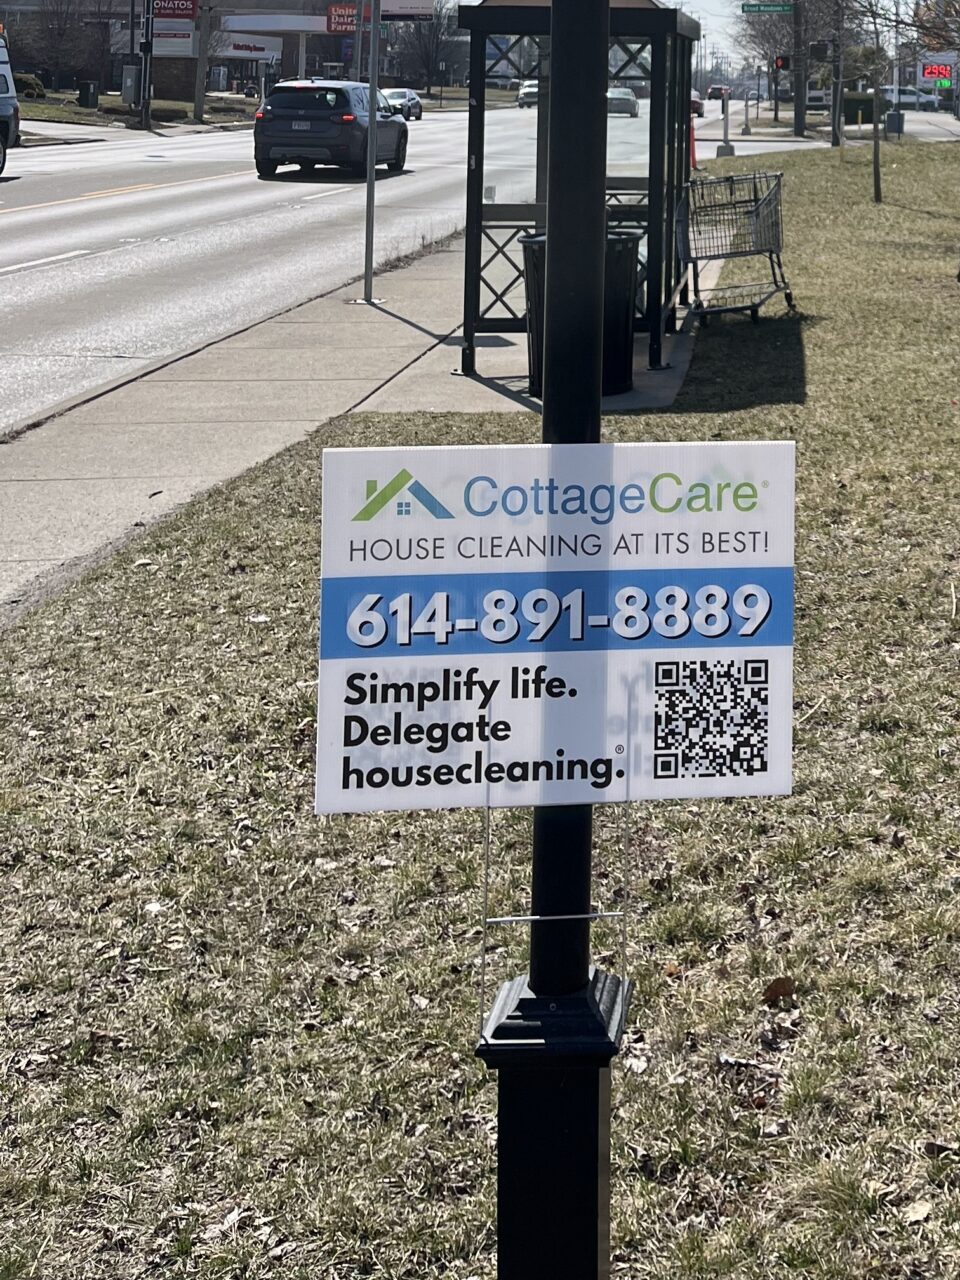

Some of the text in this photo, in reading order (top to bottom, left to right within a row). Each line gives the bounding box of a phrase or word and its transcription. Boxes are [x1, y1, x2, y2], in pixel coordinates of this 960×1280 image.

[153, 0, 193, 9] ONATOS
[331, 7, 357, 15] Unite
[330, 23, 357, 31] Farm
[349, 530, 769, 562] HOUSE CLEANING AT ITS BEST!
[345, 583, 772, 648] 614-891-8889
[343, 665, 578, 711] Simplify life.
[342, 713, 512, 753] Delegate
